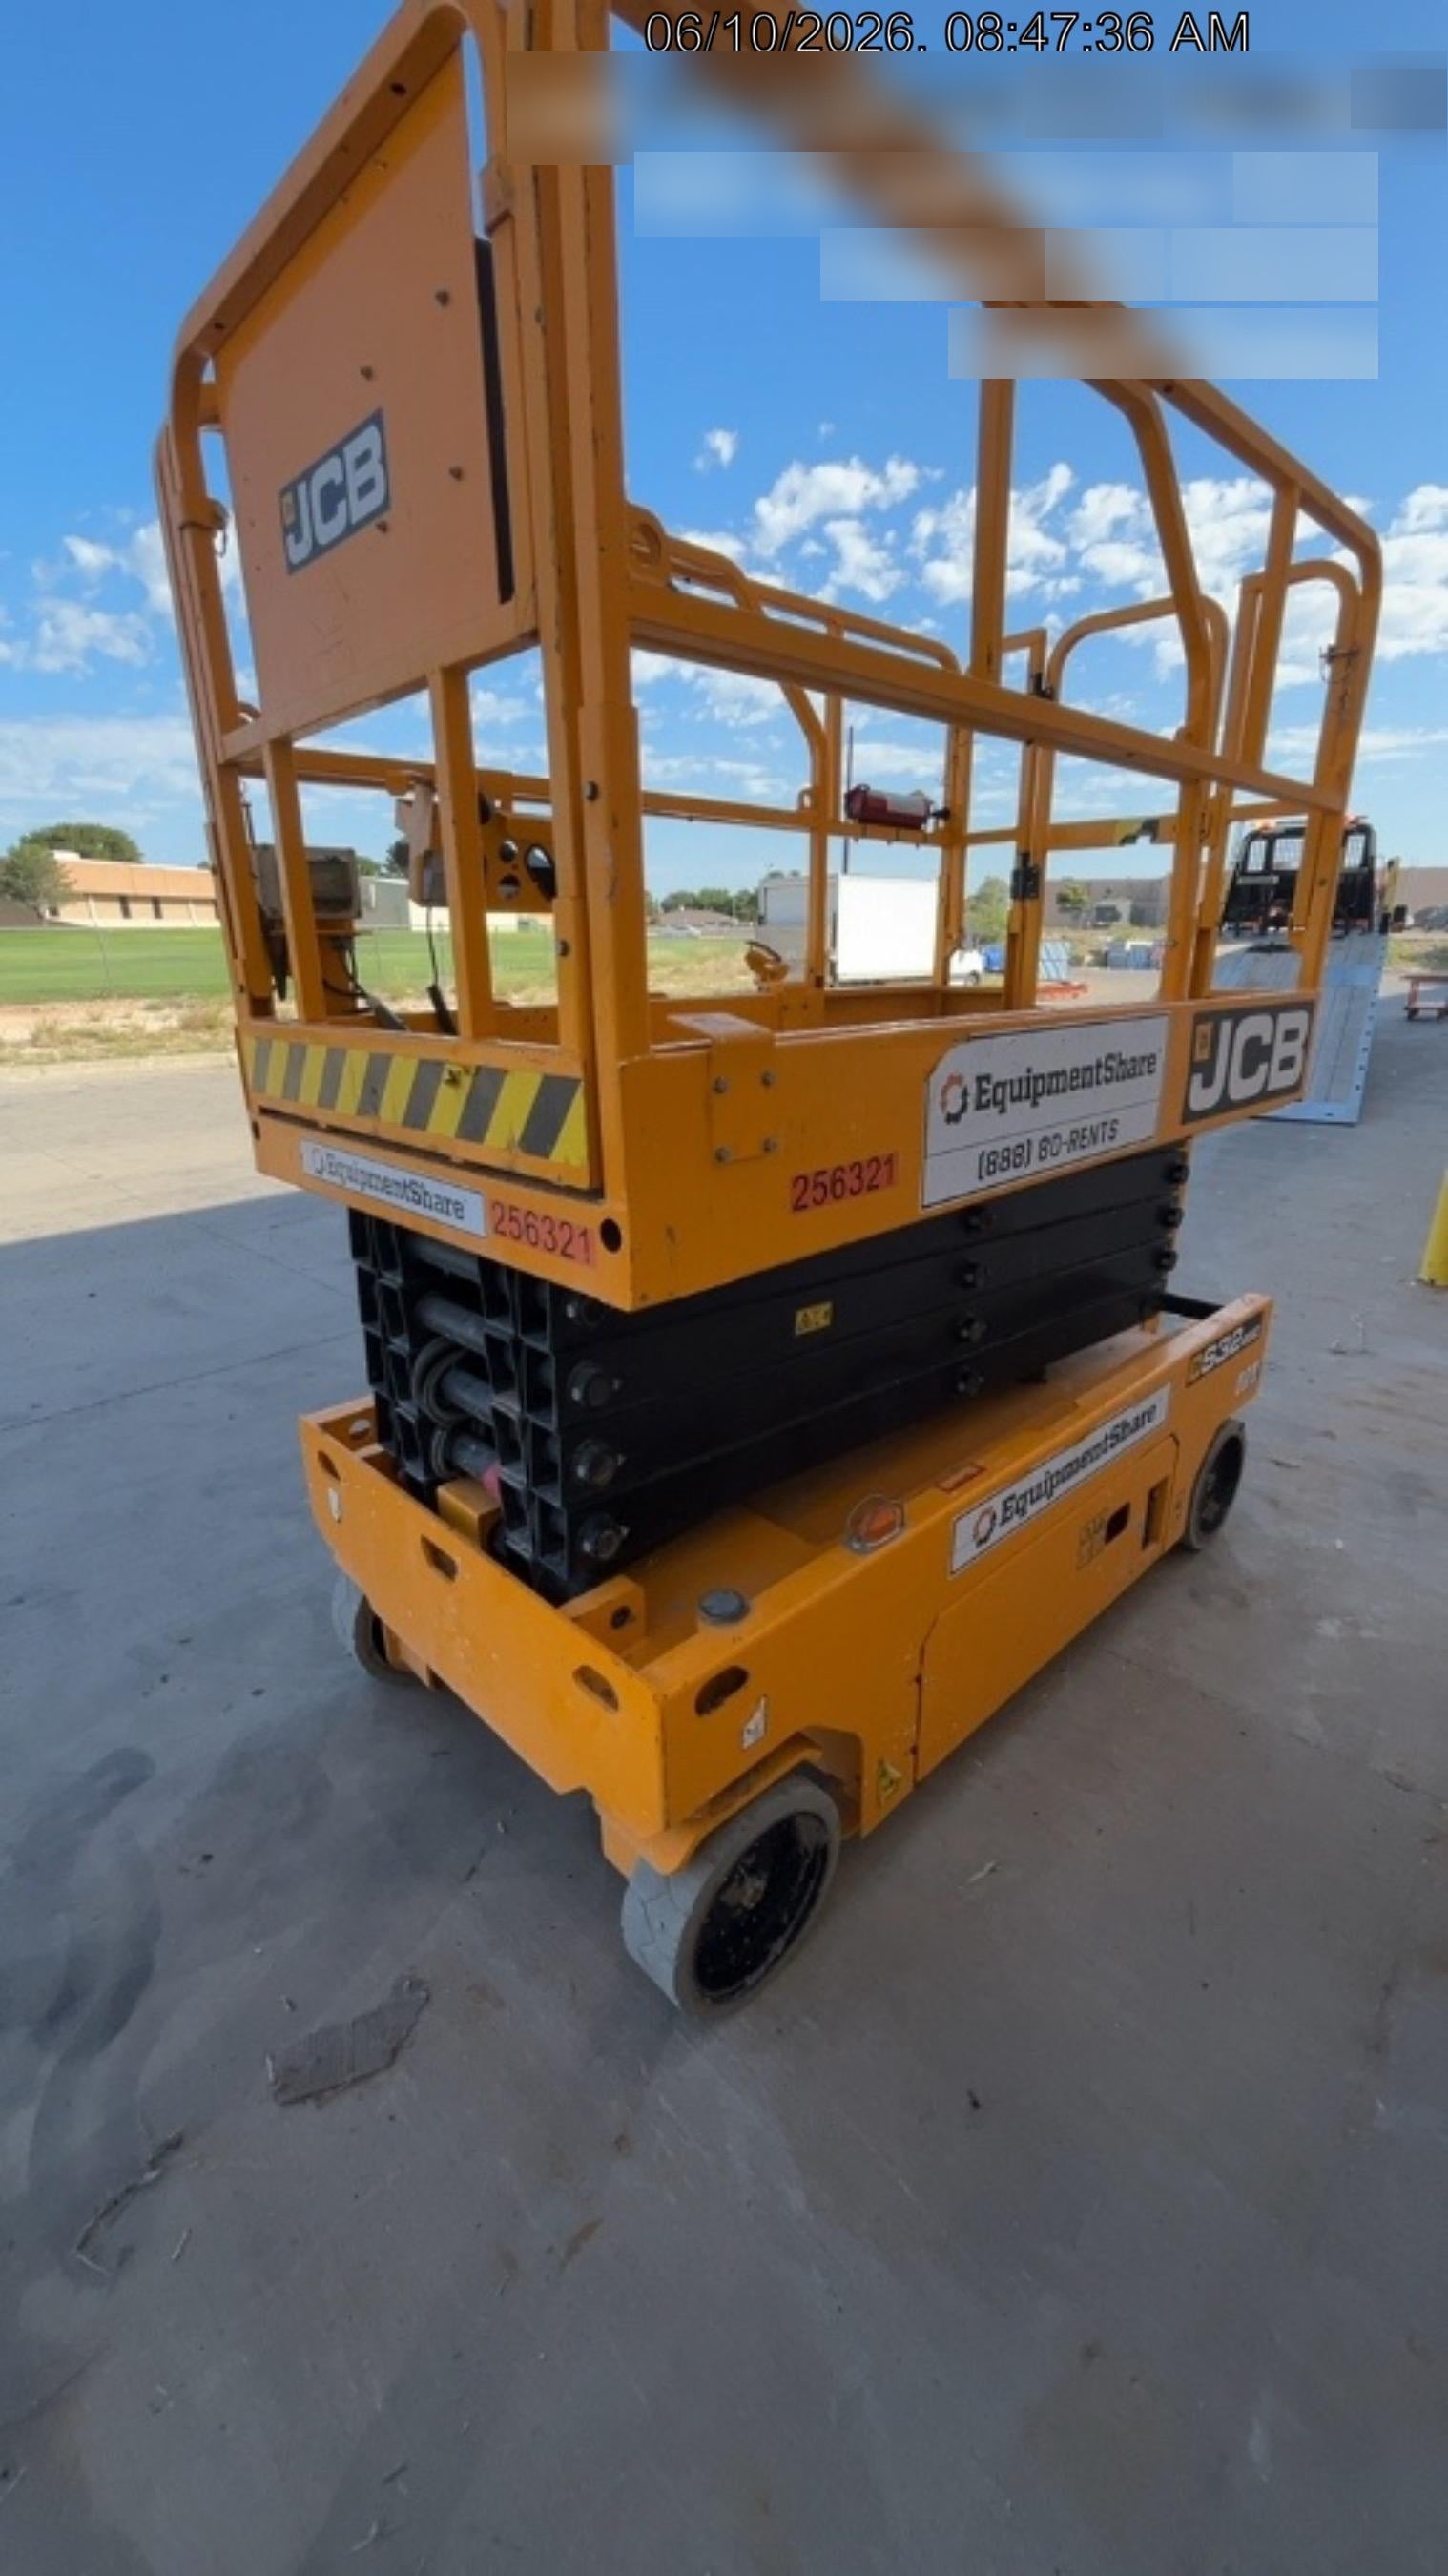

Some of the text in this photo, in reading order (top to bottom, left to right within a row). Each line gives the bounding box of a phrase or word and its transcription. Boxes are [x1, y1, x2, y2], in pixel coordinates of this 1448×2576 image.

[287, 425, 385, 565] JCB
[974, 1051, 1157, 1114] EquipmentShare
[1189, 1010, 1309, 1111] JCB
[326, 1153, 465, 1220] EquipmentShare
[791, 1153, 897, 1214] 256321
[978, 1138, 1032, 1180] (888)
[492, 1202, 591, 1262] 256321
[999, 1403, 1158, 1527] EquipmentShare
